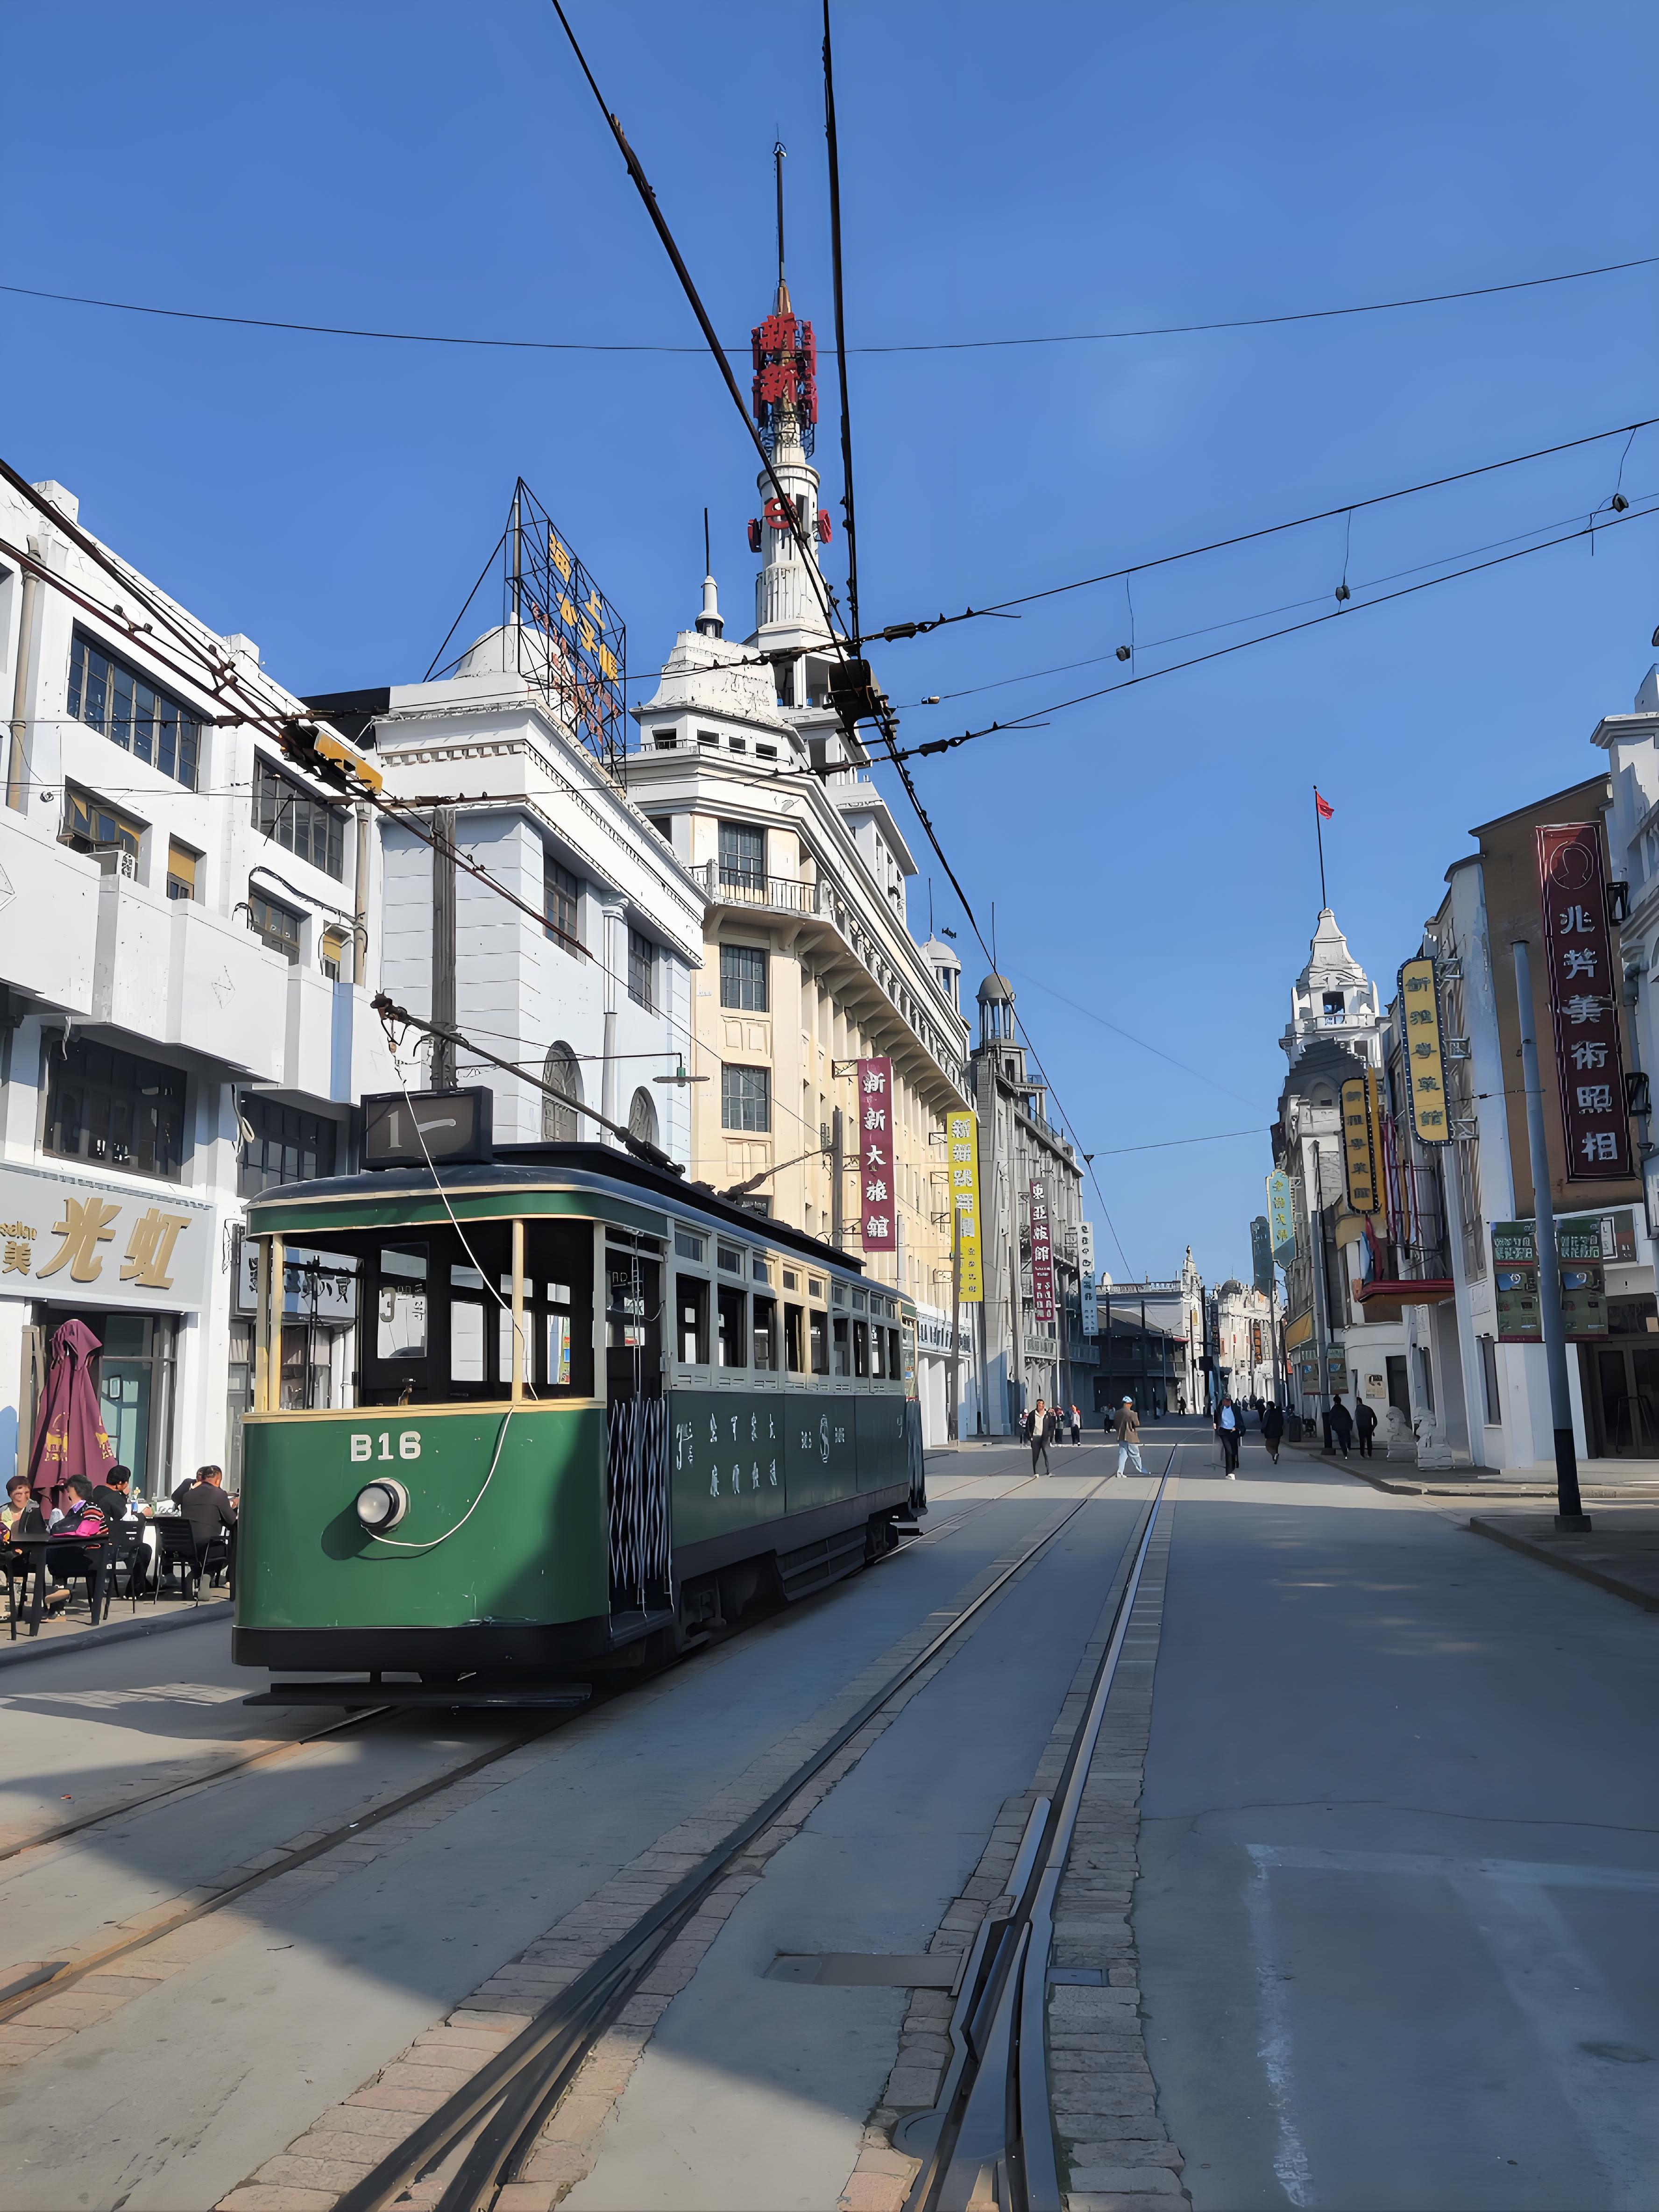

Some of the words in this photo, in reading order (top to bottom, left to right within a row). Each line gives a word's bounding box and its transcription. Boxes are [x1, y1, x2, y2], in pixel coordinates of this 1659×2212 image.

[1560, 905, 1618, 1162] 兆芳美術照相
[351, 1431, 421, 1462] B16
